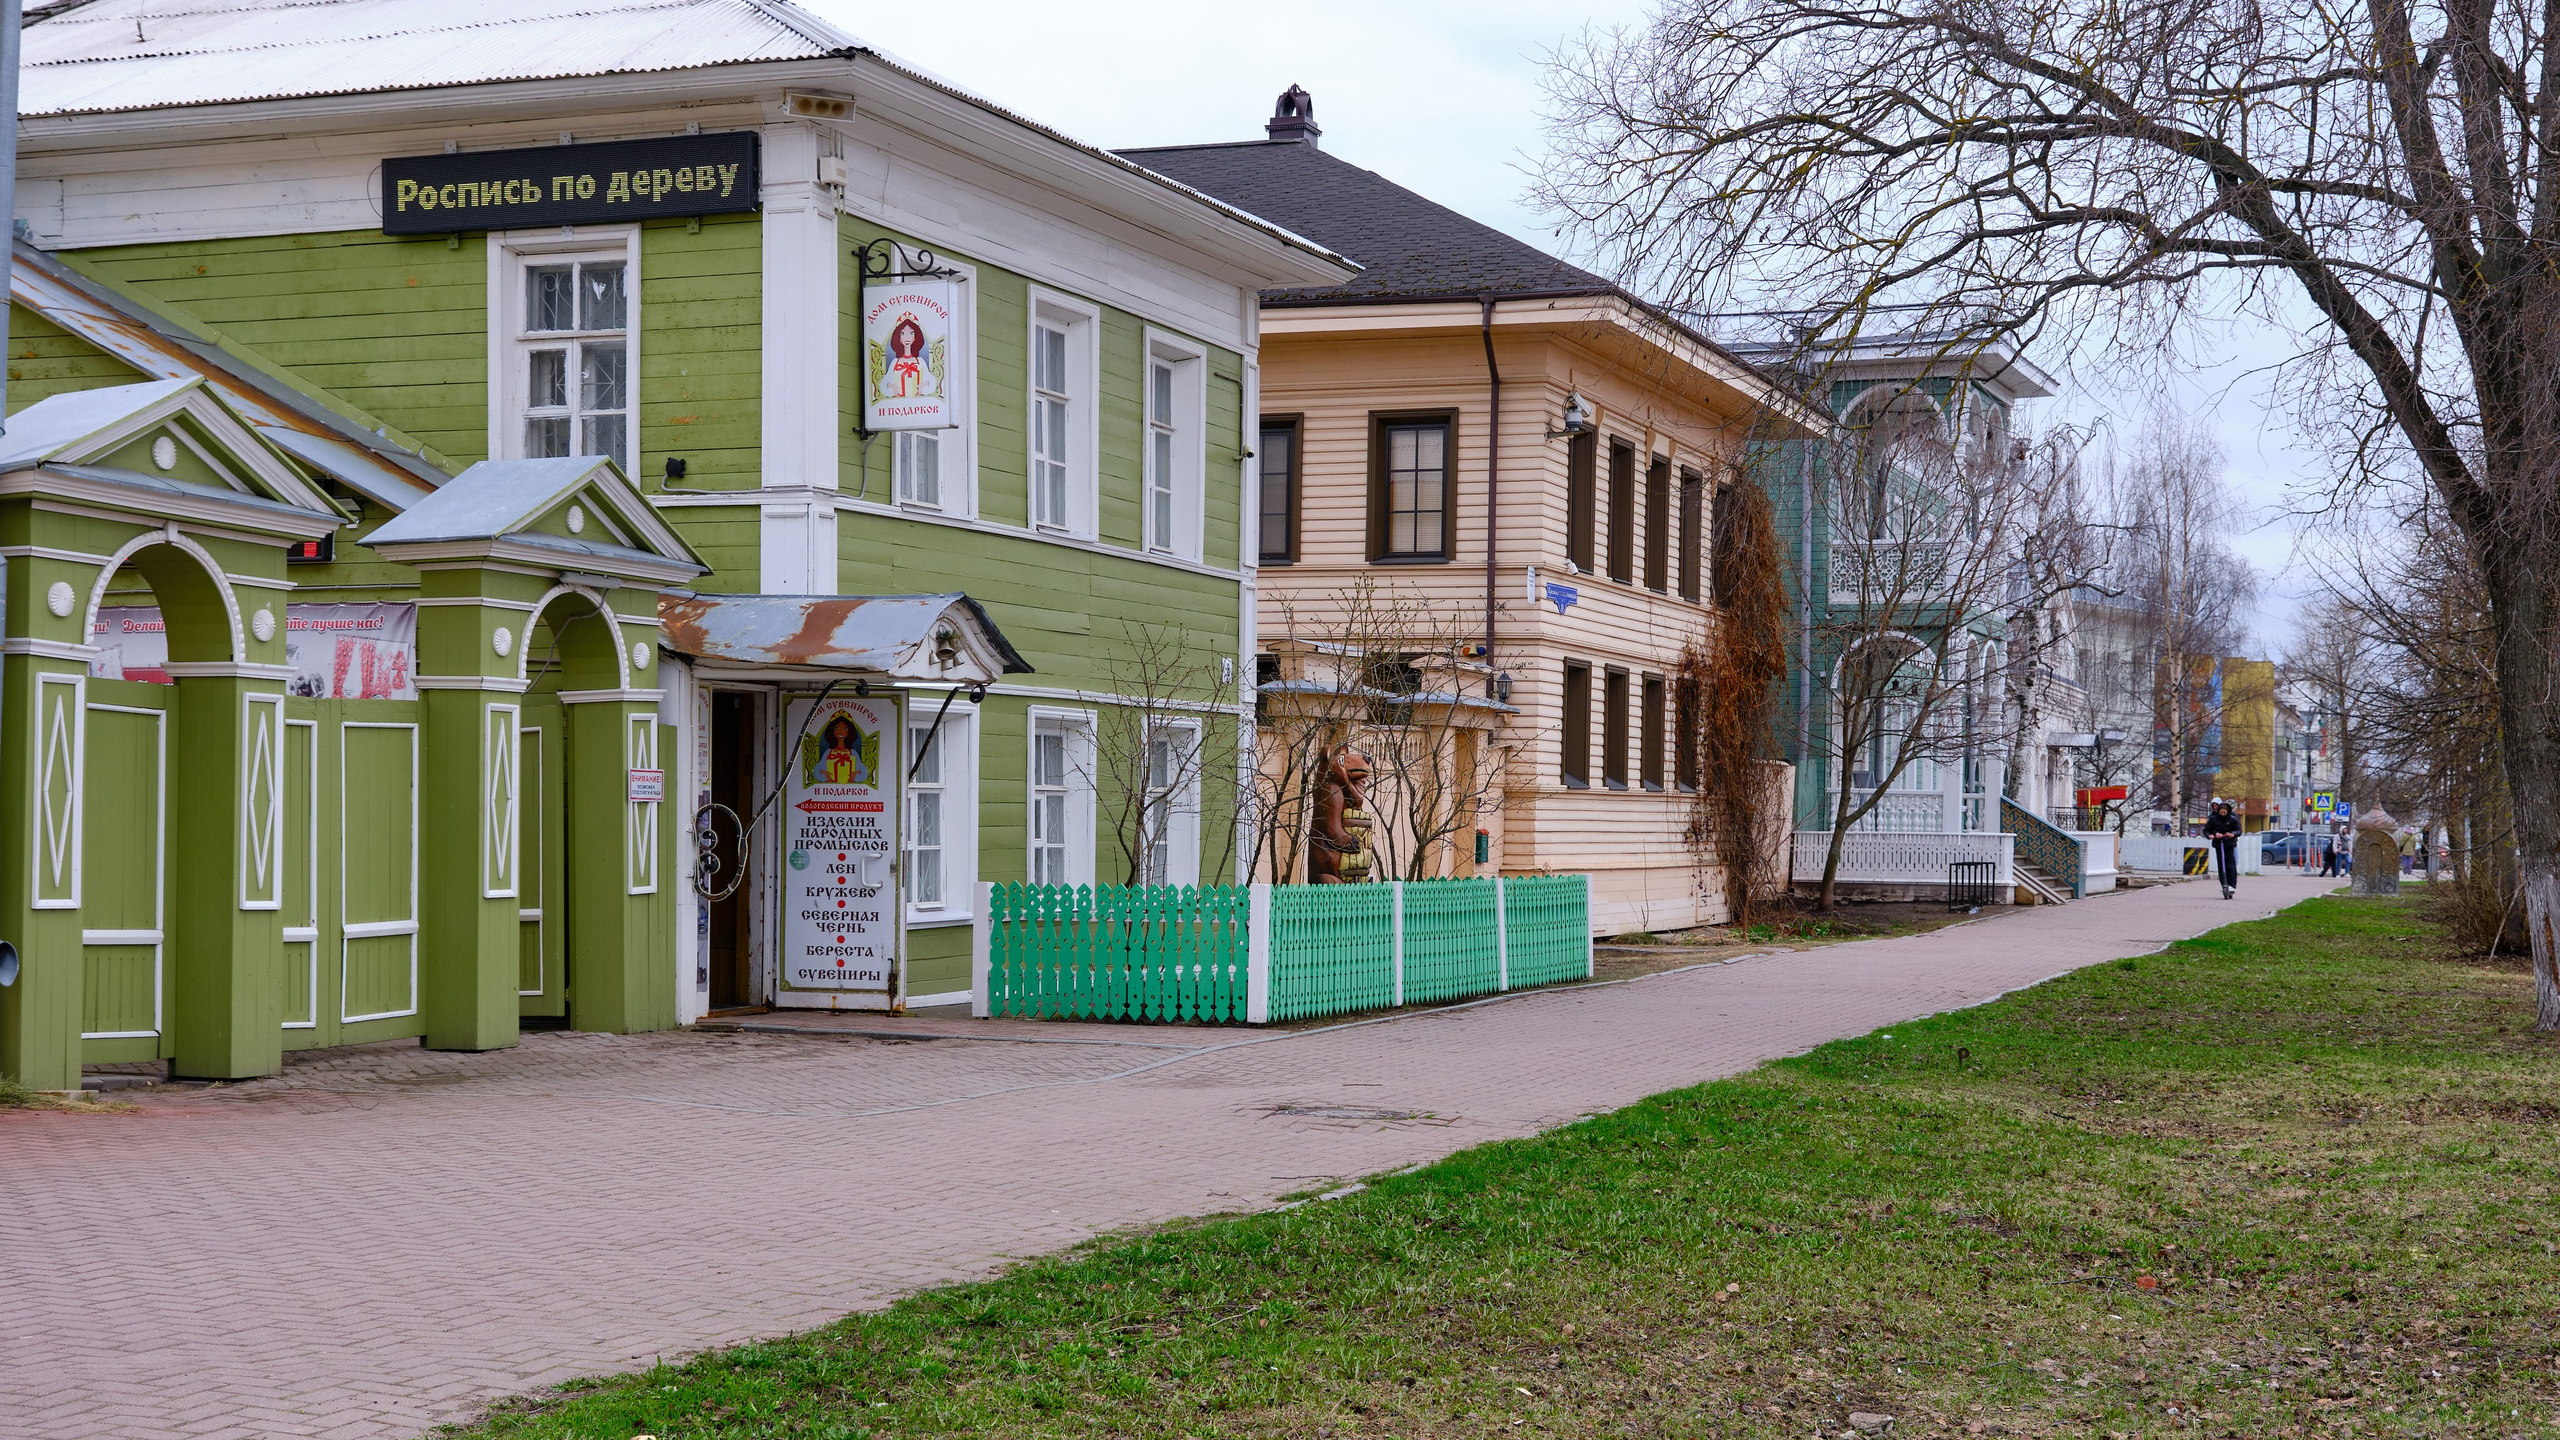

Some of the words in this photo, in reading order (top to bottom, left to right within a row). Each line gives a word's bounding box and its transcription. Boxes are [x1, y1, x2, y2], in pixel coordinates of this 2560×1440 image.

[397, 178, 542, 212] Роспись
[552, 174, 596, 201] по
[606, 163, 739, 204] дереву
[867, 302, 888, 325] ДОМ
[889, 294, 948, 320] СУВЕНИРОВ
[878, 408, 885, 417] И
[888, 405, 939, 417] ПОДАРКОВ
[310, 619, 354, 633] лучше
[356, 615, 384, 629] нас!
[826, 700, 878, 724] СУВЕНИРОВ
[814, 788, 820, 796] И
[822, 788, 869, 797] ПОДАРКОВ
[800, 803, 849, 811] ВОЛОГОДСКИЙ
[850, 803, 883, 811] ПРОДУКТ
[807, 816, 876, 828] ИЗДЕЛИЯ
[800, 828, 882, 840] НАРОДНЫХ
[795, 839, 889, 851] ПРОМЫСЛОВ
[826, 863, 856, 874] ЛЕН
[806, 886, 876, 900] КРУЖЕВО
[801, 910, 880, 922] СЕВЕРНАЯ
[816, 922, 866, 933] ЧЕРНЬ
[806, 945, 874, 957] БЕРЕСТА
[798, 969, 881, 982] СУВЕНИРЫ
